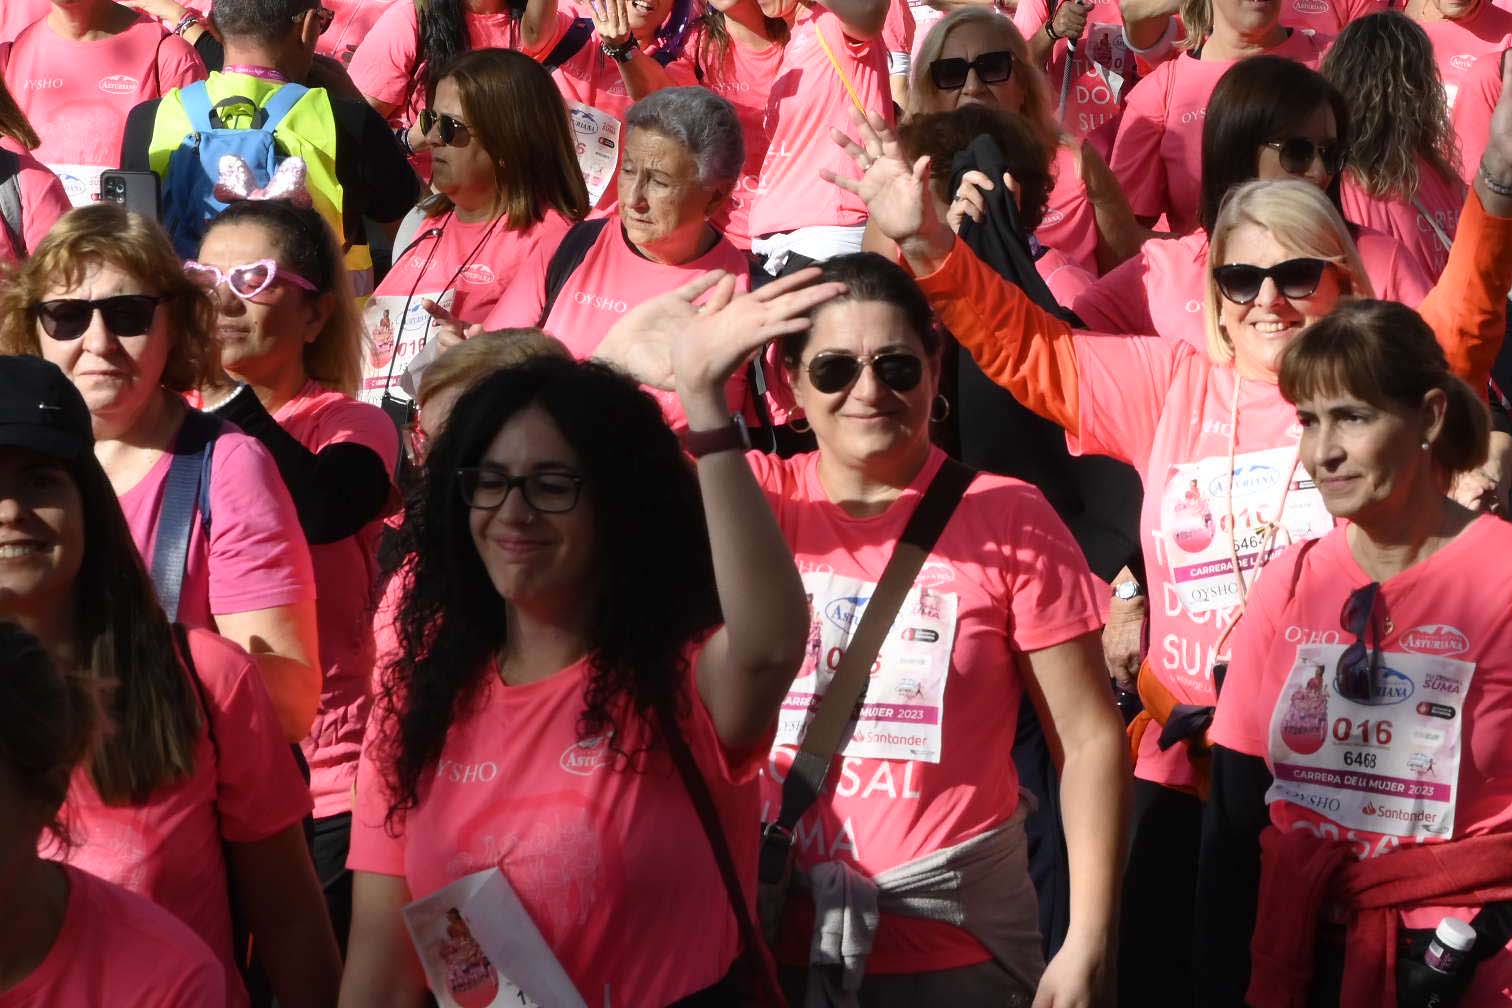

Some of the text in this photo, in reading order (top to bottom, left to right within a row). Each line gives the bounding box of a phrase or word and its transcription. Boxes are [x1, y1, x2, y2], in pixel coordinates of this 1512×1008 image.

[1181, 108, 1207, 124] OYS
[573, 291, 627, 313] OYSHO
[1189, 563, 1235, 577] CARRERA
[1405, 634, 1464, 652] ASTURIANA
[1163, 633, 1232, 681] SU
[1422, 679, 1460, 694] SUMA
[897, 709, 924, 720] 2023
[866, 731, 928, 747] Santander
[1332, 717, 1393, 745] 016
[1343, 751, 1377, 769] 6468
[769, 746, 920, 799] OSAL
[1293, 769, 1341, 785] CARRERA
[1368, 779, 1405, 792] MUJER
[1407, 784, 1435, 796] 2023
[1376, 805, 1437, 823] Santander
